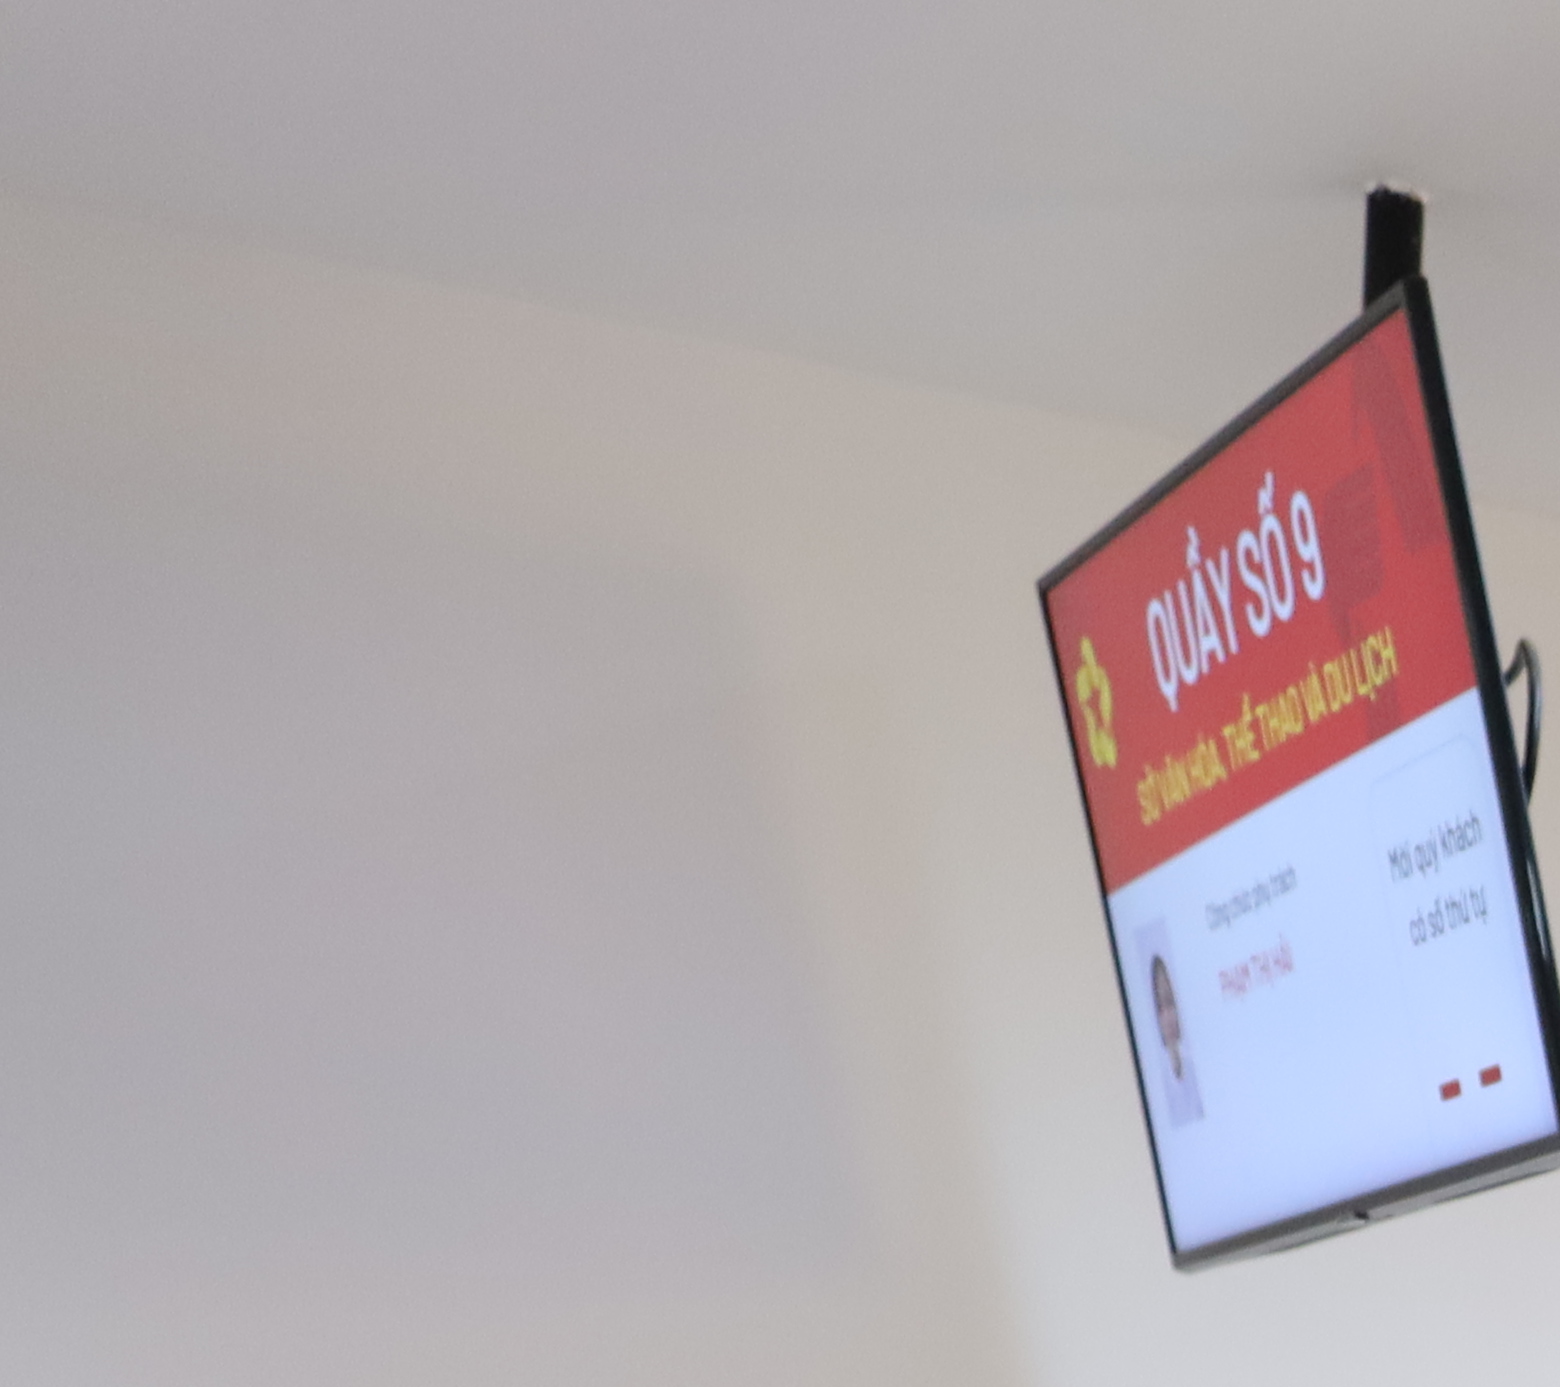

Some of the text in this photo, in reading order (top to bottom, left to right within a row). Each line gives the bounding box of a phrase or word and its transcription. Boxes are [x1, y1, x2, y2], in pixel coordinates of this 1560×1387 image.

[1236, 469, 1295, 638] SỐ
[1290, 490, 1325, 600] 9
[1350, 625, 1398, 701] LỊCH
[1414, 827, 1439, 879] quý
[1437, 809, 1483, 858] khách
[1409, 905, 1427, 947] có
[1427, 893, 1445, 939] số
